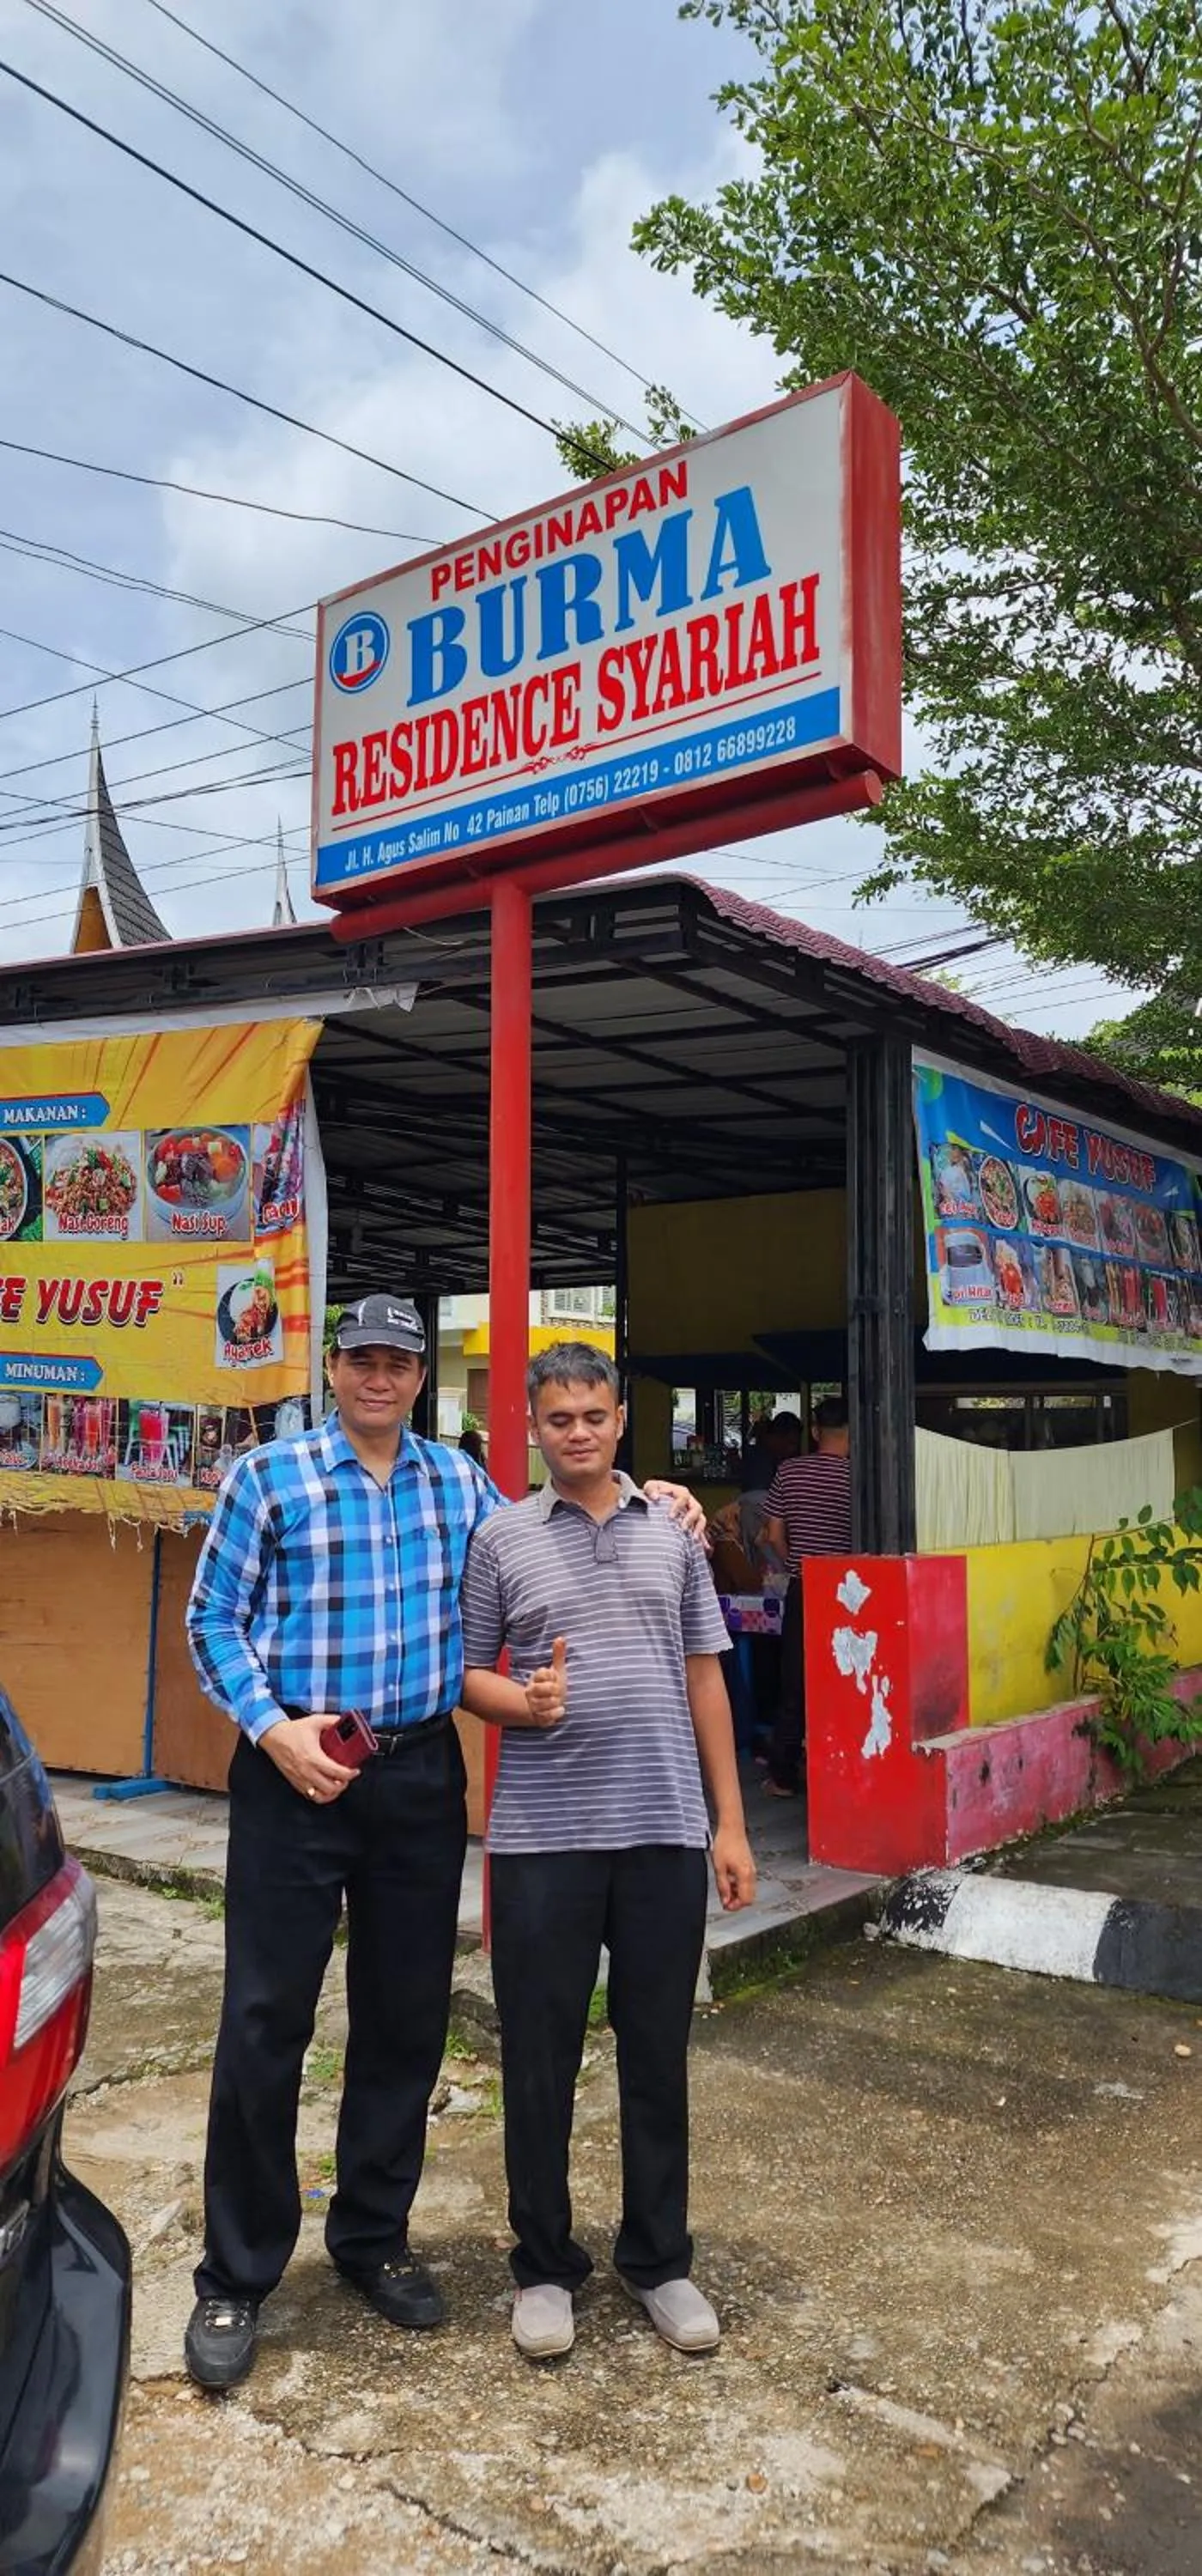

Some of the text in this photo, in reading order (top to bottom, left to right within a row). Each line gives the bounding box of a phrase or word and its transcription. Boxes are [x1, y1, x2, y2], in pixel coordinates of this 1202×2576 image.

[406, 485, 772, 708] BURMA
[431, 460, 687, 601] PENGINAPAN
[331, 573, 820, 816] RESIDENCE SYARIAH
[344, 853, 359, 872] Jl.
[362, 849, 373, 865] H.
[378, 841, 405, 865] Agus
[408, 829, 440, 853] Salim
[444, 822, 459, 844] No
[467, 815, 483, 835] 42
[487, 805, 530, 831] Painan
[534, 792, 559, 817] Telp
[564, 776, 609, 812] (0756)
[614, 760, 659, 793] 22219
[674, 743, 712, 775] 0812
[717, 716, 797, 762] 66899228
[3, 1105, 78, 1123] MAKANAN
[6, 1363, 77, 1382] MINUMAN
[36, 1277, 164, 1327] YUSUF
